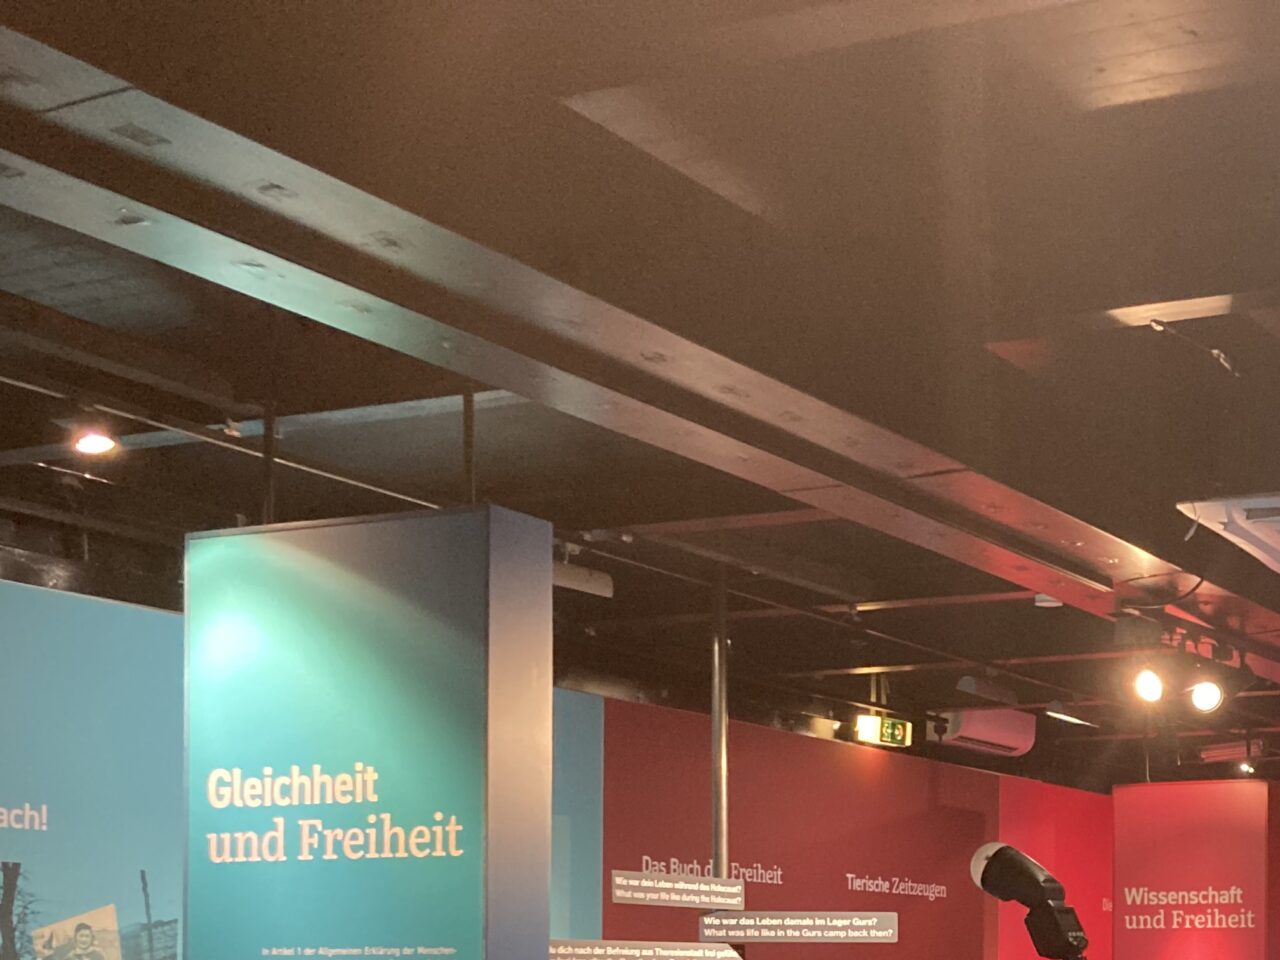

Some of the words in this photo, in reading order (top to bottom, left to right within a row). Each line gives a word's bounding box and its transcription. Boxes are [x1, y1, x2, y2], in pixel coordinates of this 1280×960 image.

[207, 762, 379, 809] Gleichheit
[207, 818, 286, 863] und
[298, 812, 464, 861] Freiheit
[642, 856, 666, 874] Das
[670, 858, 701, 877] Buch
[731, 863, 784, 885] Freiheit
[846, 873, 890, 893] Tierische
[891, 877, 947, 902] Zeitzeugen
[1124, 886, 1243, 905] Wissenschaft
[703, 916, 720, 925] Wie
[738, 917, 754, 925] das
[755, 917, 782, 925] Leben
[783, 917, 813, 925] damals
[814, 917, 825, 925] im
[826, 917, 850, 927] Lager
[851, 916, 878, 926] Gurs?
[1124, 910, 1166, 929] und
[1171, 908, 1256, 929] Freiheit
[703, 928, 726, 936] What
[745, 928, 759, 936] life
[760, 928, 775, 936] like
[776, 928, 785, 936] in
[786, 928, 800, 936] the
[801, 928, 822, 937] Gurs
[823, 930, 846, 938] camp
[847, 928, 868, 937] back
[869, 928, 893, 937] then?
